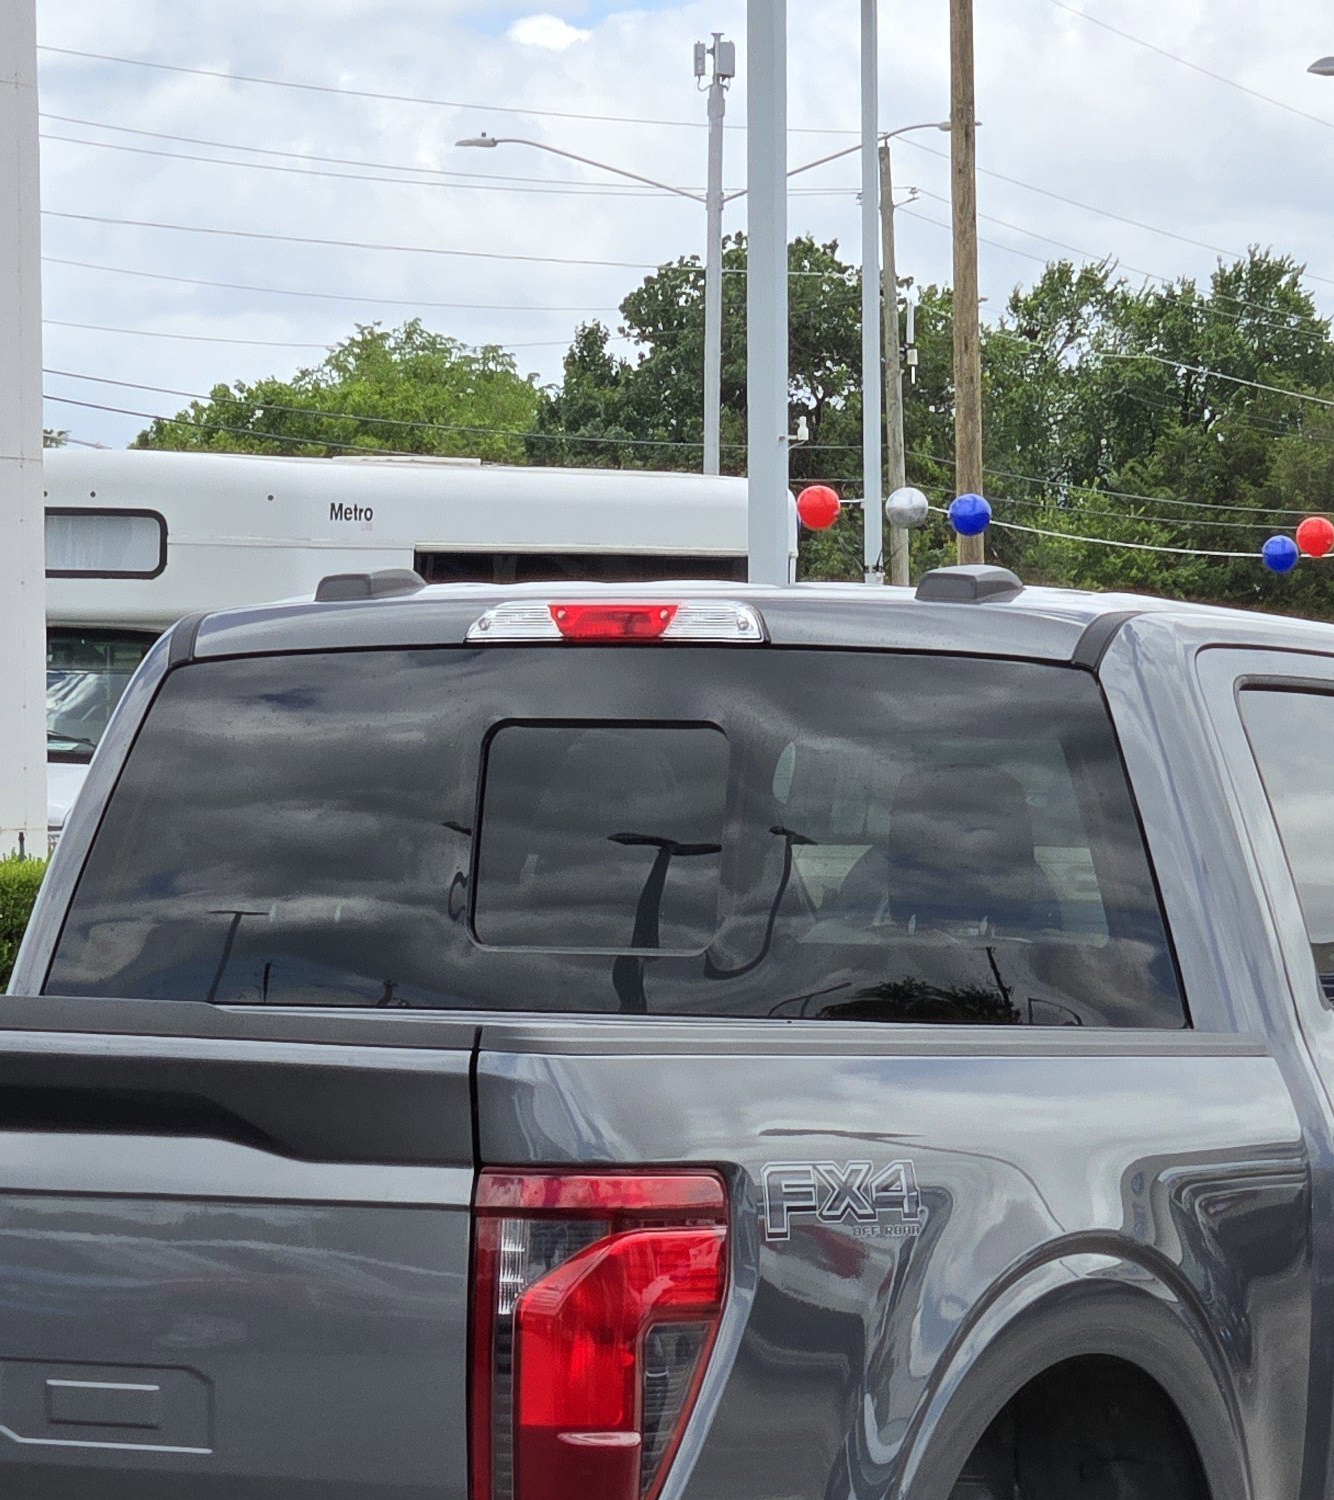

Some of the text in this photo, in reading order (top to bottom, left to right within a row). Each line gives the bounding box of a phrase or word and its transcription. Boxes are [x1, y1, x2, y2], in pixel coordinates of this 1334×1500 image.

[329, 502, 374, 521] Metro
[760, 1159, 922, 1241] FX4
[853, 1226, 880, 1236] OFF
